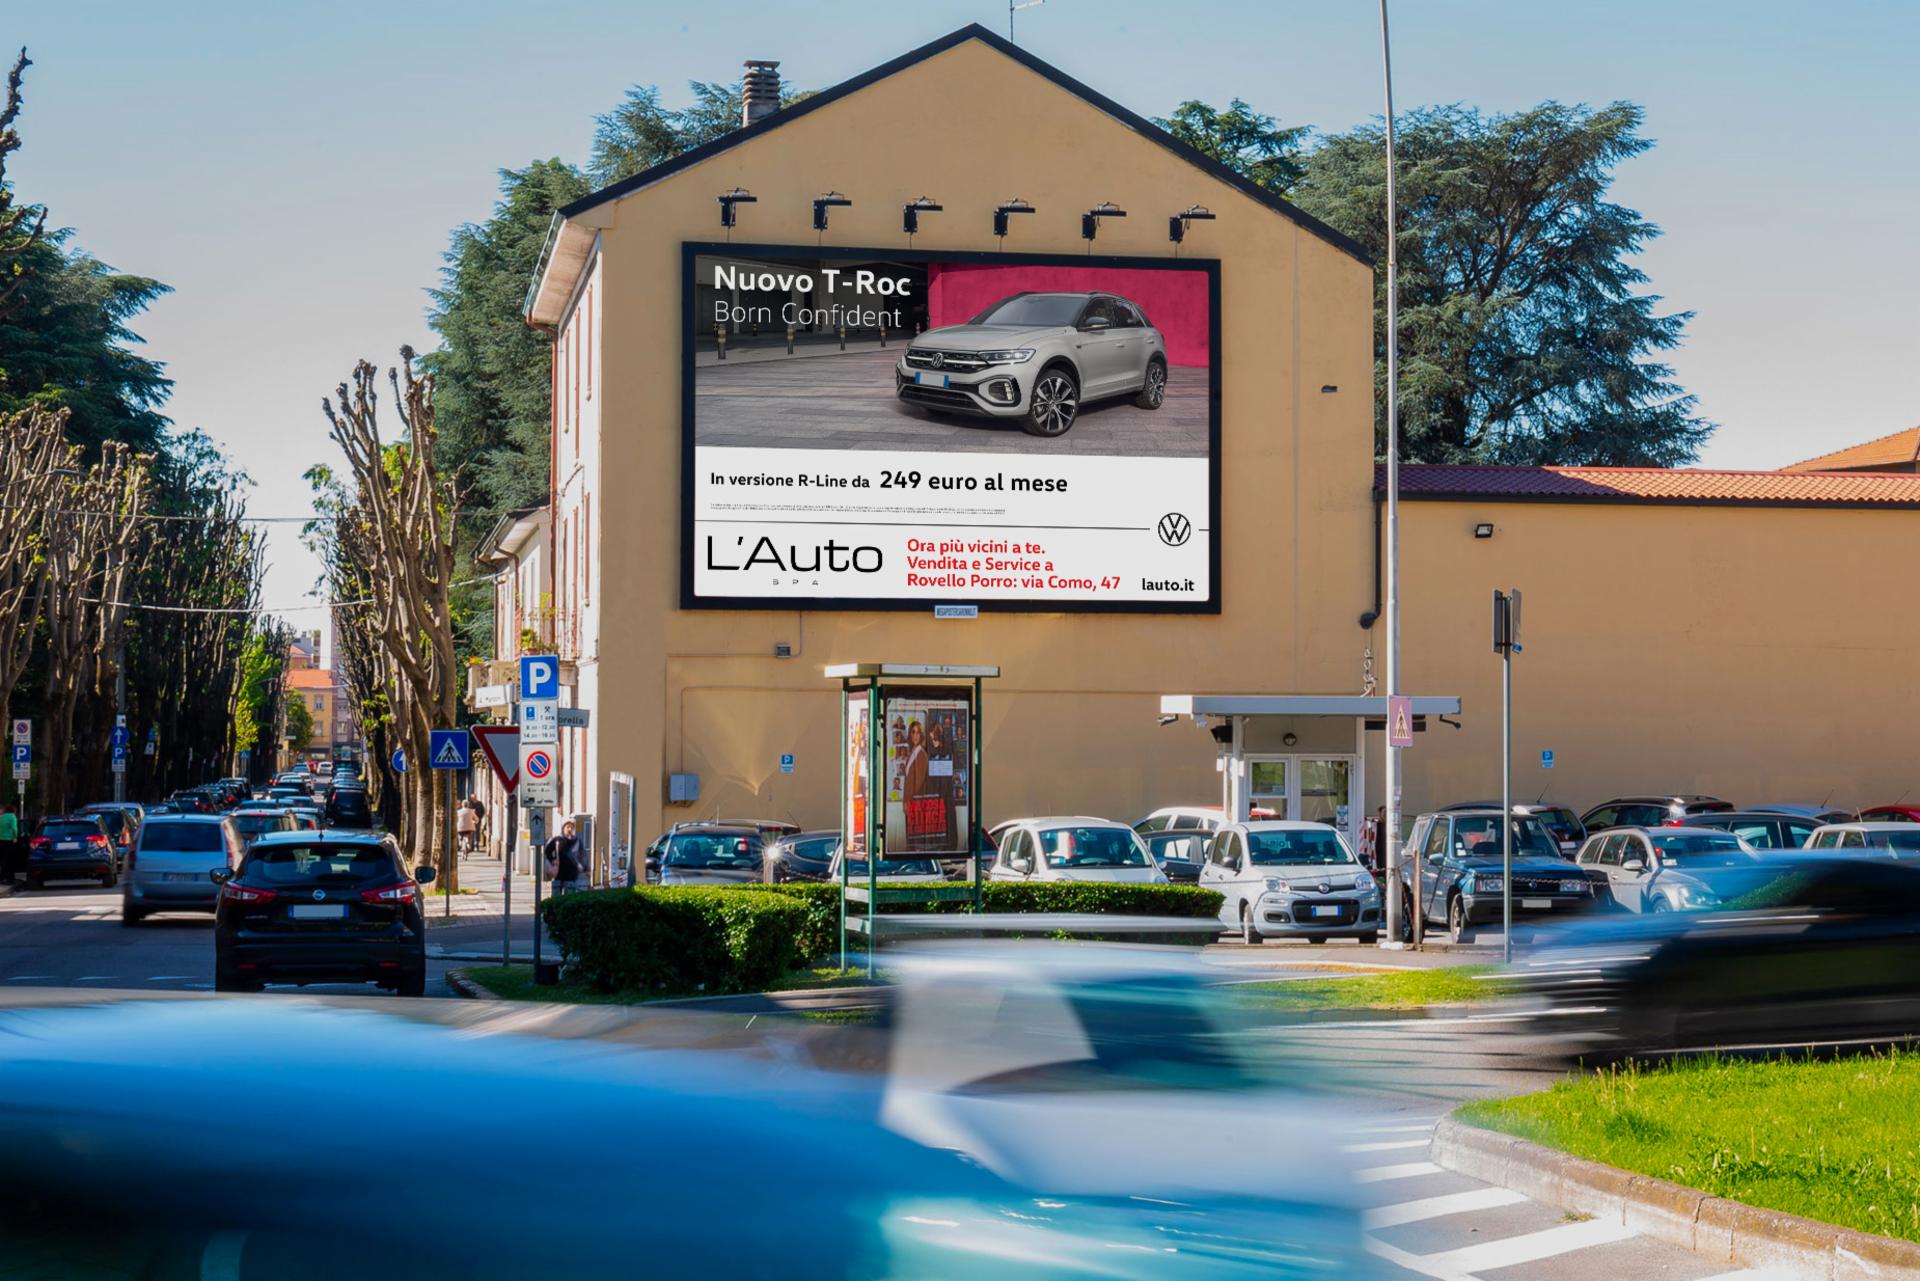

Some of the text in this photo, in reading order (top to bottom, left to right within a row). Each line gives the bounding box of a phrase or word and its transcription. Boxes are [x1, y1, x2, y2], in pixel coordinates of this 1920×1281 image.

[714, 265, 911, 296] Nuovo T-Roc
[715, 300, 902, 328] Born Confident
[710, 471, 1068, 492] In versione R-Line da 249 euro al mese
[707, 535, 883, 573] L'Auto
[907, 539, 1046, 555] Ora più vicini a te.
[907, 556, 1054, 572] Vendita e Service a
[907, 573, 1121, 592] Rovello Porro: via Como, 47
[1142, 577, 1194, 591] lauto.it
[530, 662, 551, 694] P
[17, 747, 27, 760] P
[115, 747, 123, 757] P
